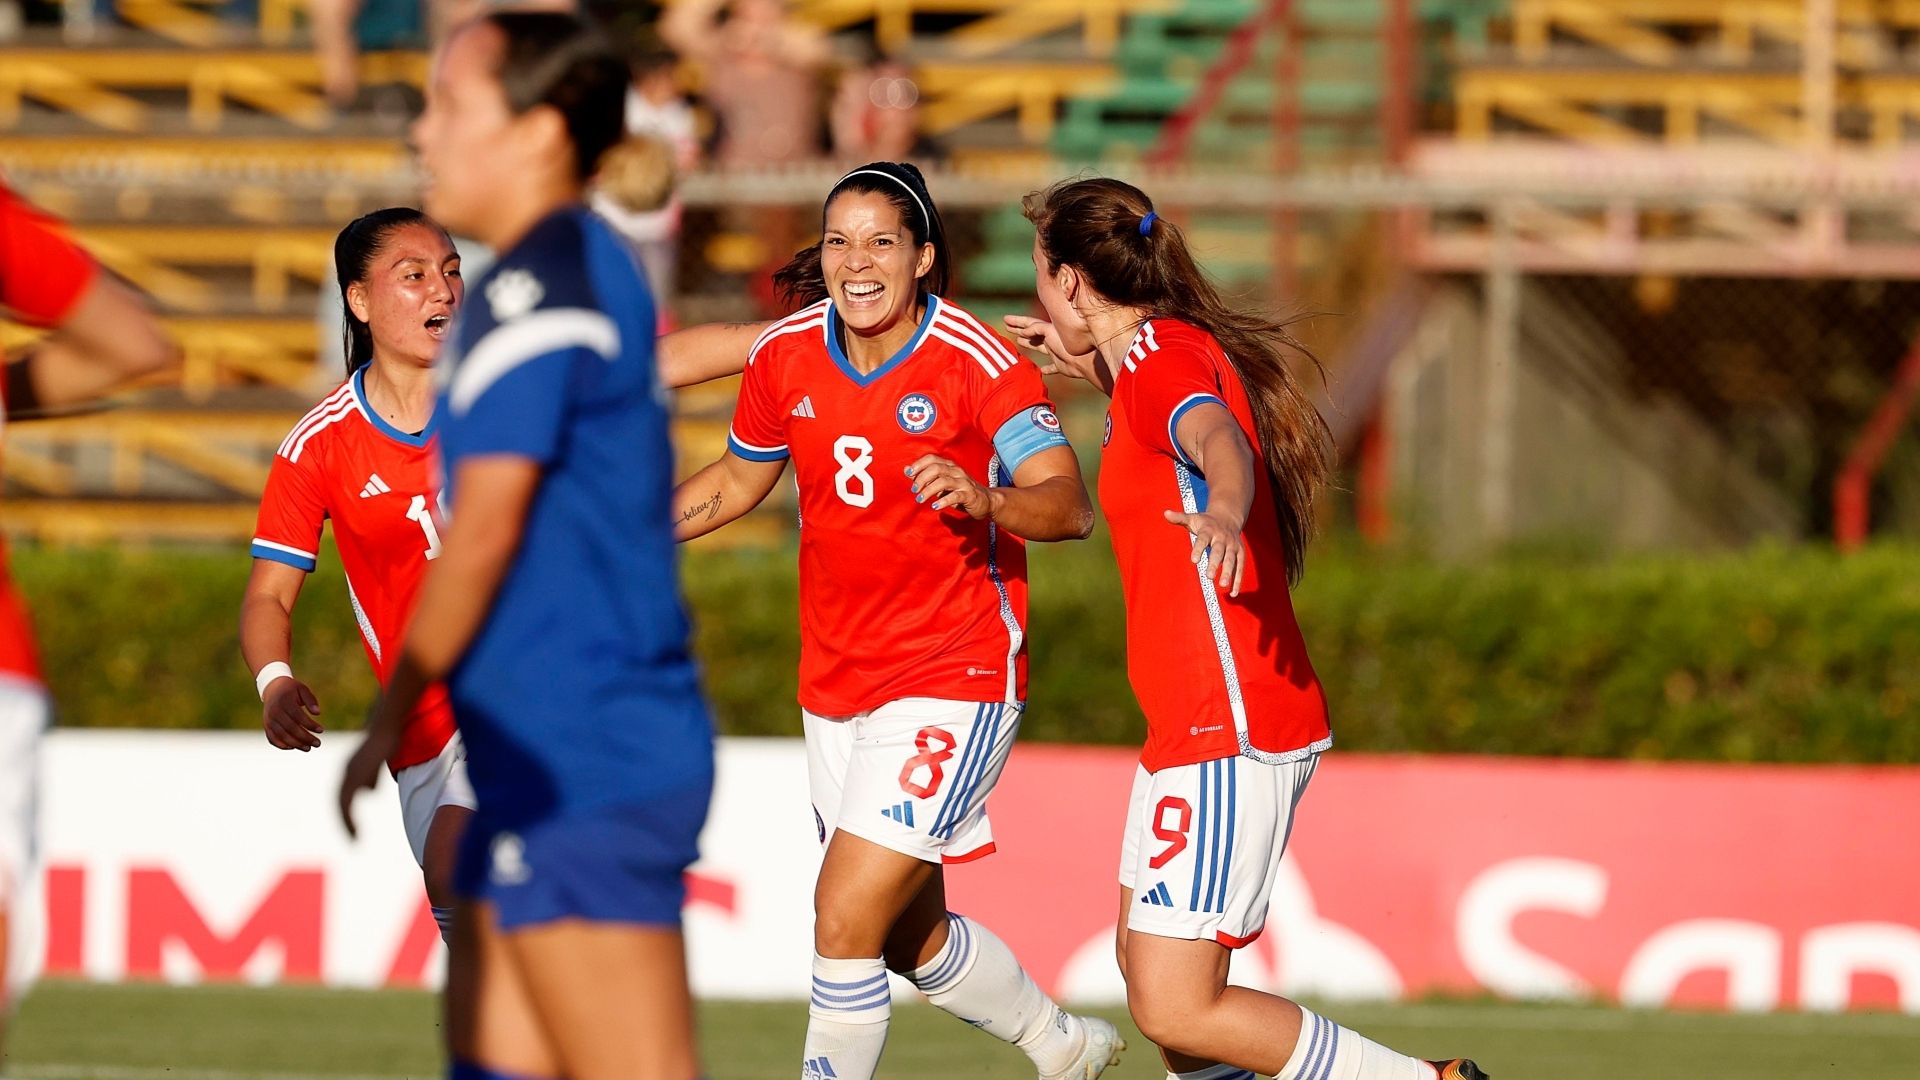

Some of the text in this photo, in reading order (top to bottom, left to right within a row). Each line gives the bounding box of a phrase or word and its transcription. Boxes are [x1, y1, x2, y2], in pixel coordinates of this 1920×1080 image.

[833, 434, 874, 509] 8
[405, 487, 449, 561] 1
[899, 725, 957, 800] 8
[1148, 796, 1193, 869] 9
